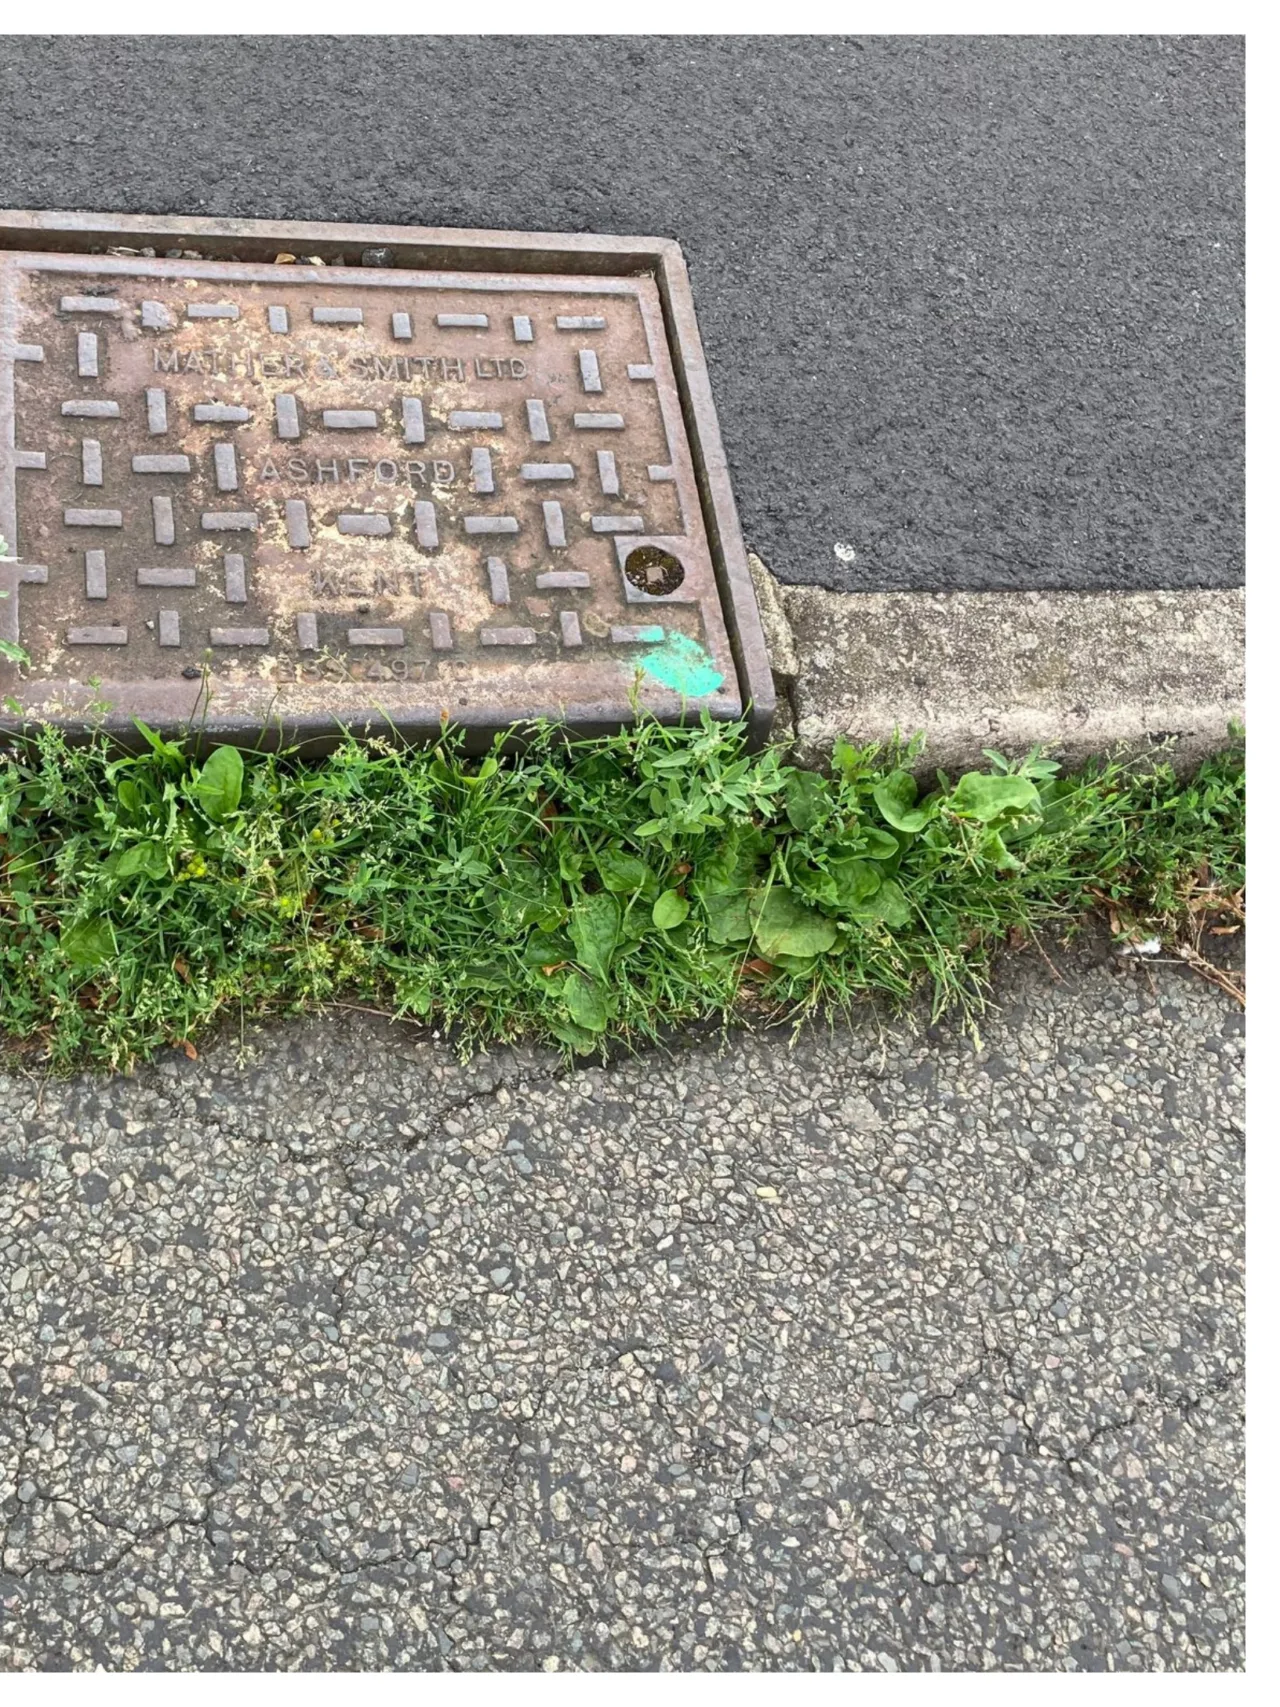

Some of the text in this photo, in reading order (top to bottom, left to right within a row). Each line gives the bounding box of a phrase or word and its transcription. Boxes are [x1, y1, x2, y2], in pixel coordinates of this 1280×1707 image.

[152, 348, 529, 382] MATHER & SMITH LTD
[260, 457, 455, 485] ASHFORD
[311, 567, 427, 597] KENT
